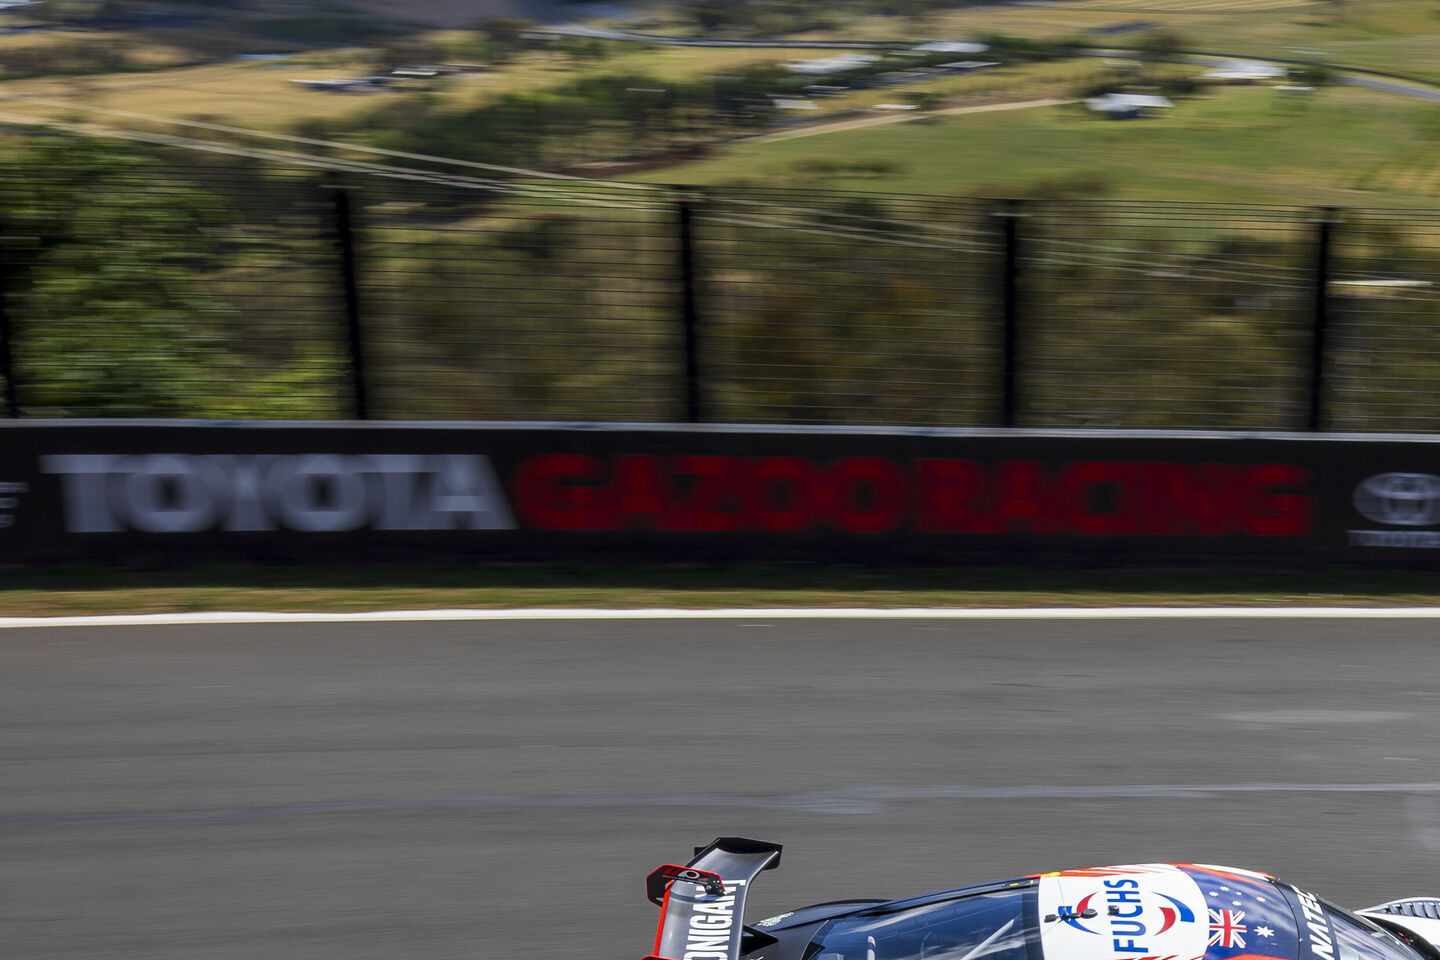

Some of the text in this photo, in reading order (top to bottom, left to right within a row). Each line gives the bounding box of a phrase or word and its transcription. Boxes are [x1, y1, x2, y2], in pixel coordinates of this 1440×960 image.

[40, 454, 518, 532] TOYOTA
[510, 454, 904, 532] GAZOO
[1103, 879, 1149, 953] FUCHS
